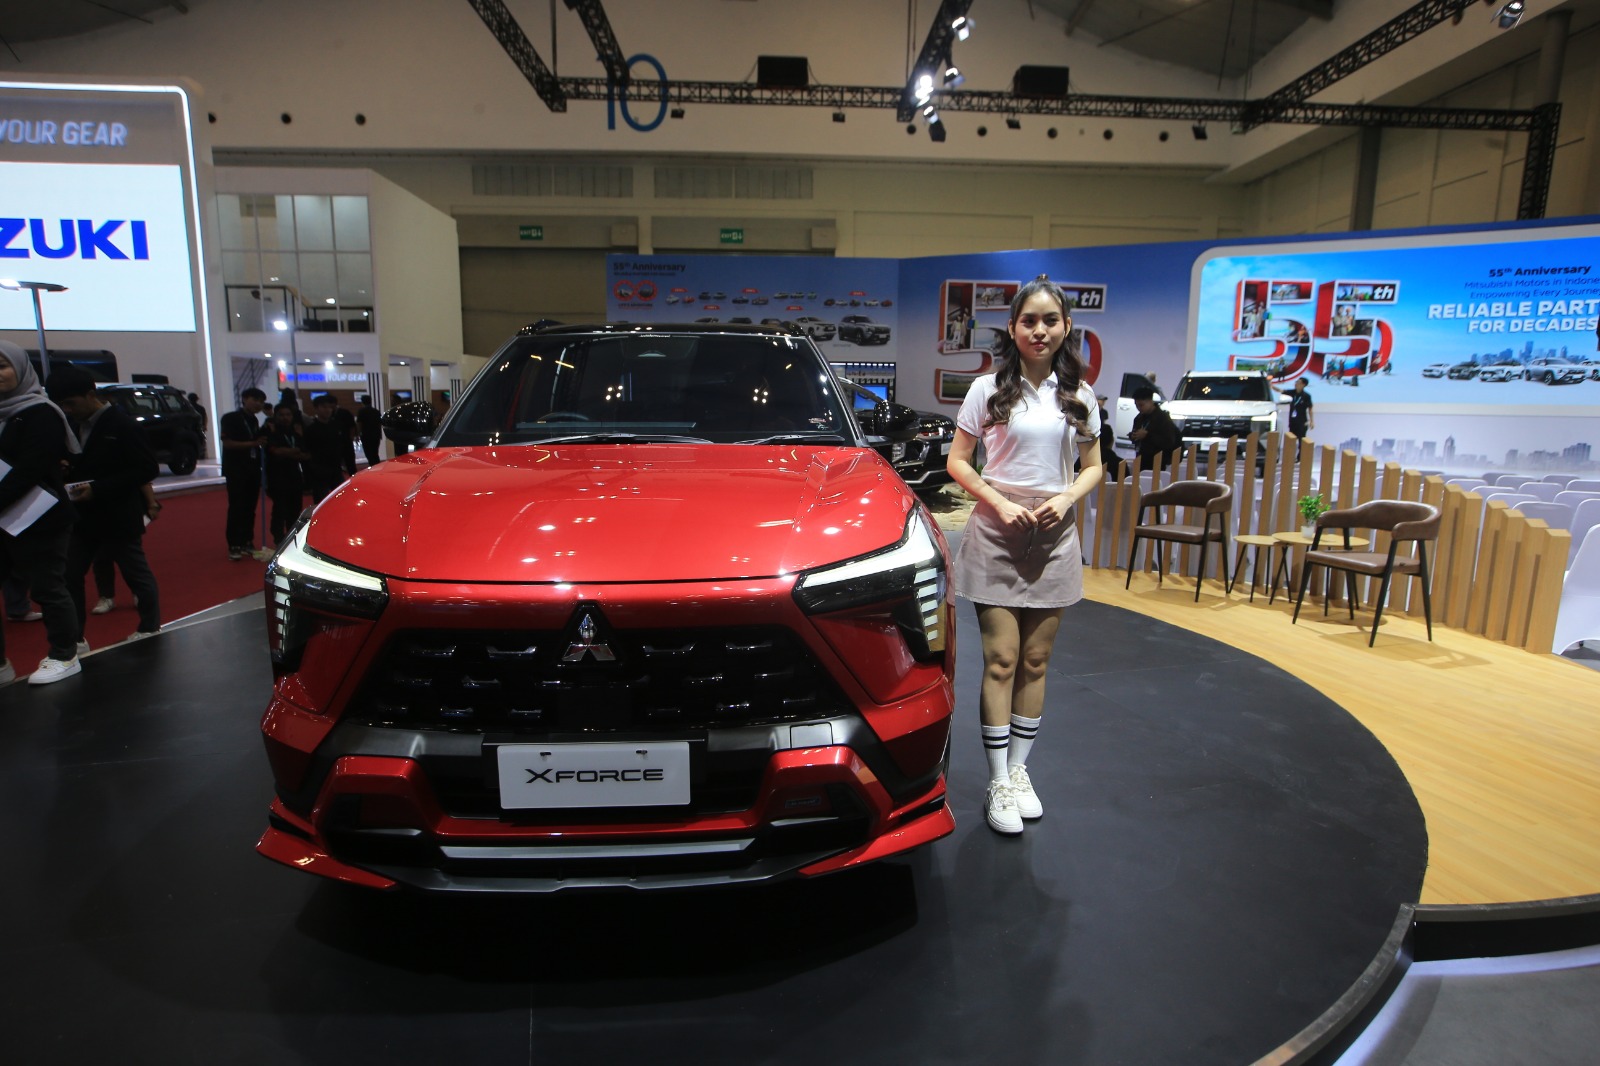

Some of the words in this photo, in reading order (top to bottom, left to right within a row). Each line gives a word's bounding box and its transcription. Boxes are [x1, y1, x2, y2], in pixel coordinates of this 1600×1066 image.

[62, 121, 128, 146] GEAR
[0, 218, 150, 261] ZUKI
[632, 262, 686, 272] Anniversary
[1514, 265, 1592, 276] Anniversary
[1464, 281, 1513, 290] Mitsubishi
[1515, 279, 1550, 288] Motors
[1552, 277, 1562, 286] in
[1470, 290, 1530, 300] Empowering
[1533, 289, 1561, 299] Every
[1427, 301, 1533, 319] RELIABLE
[1537, 299, 1600, 317] PART
[1467, 319, 1506, 333] FOR
[1509, 317, 1598, 333] DECADES
[525, 768, 664, 784] XFORCE
